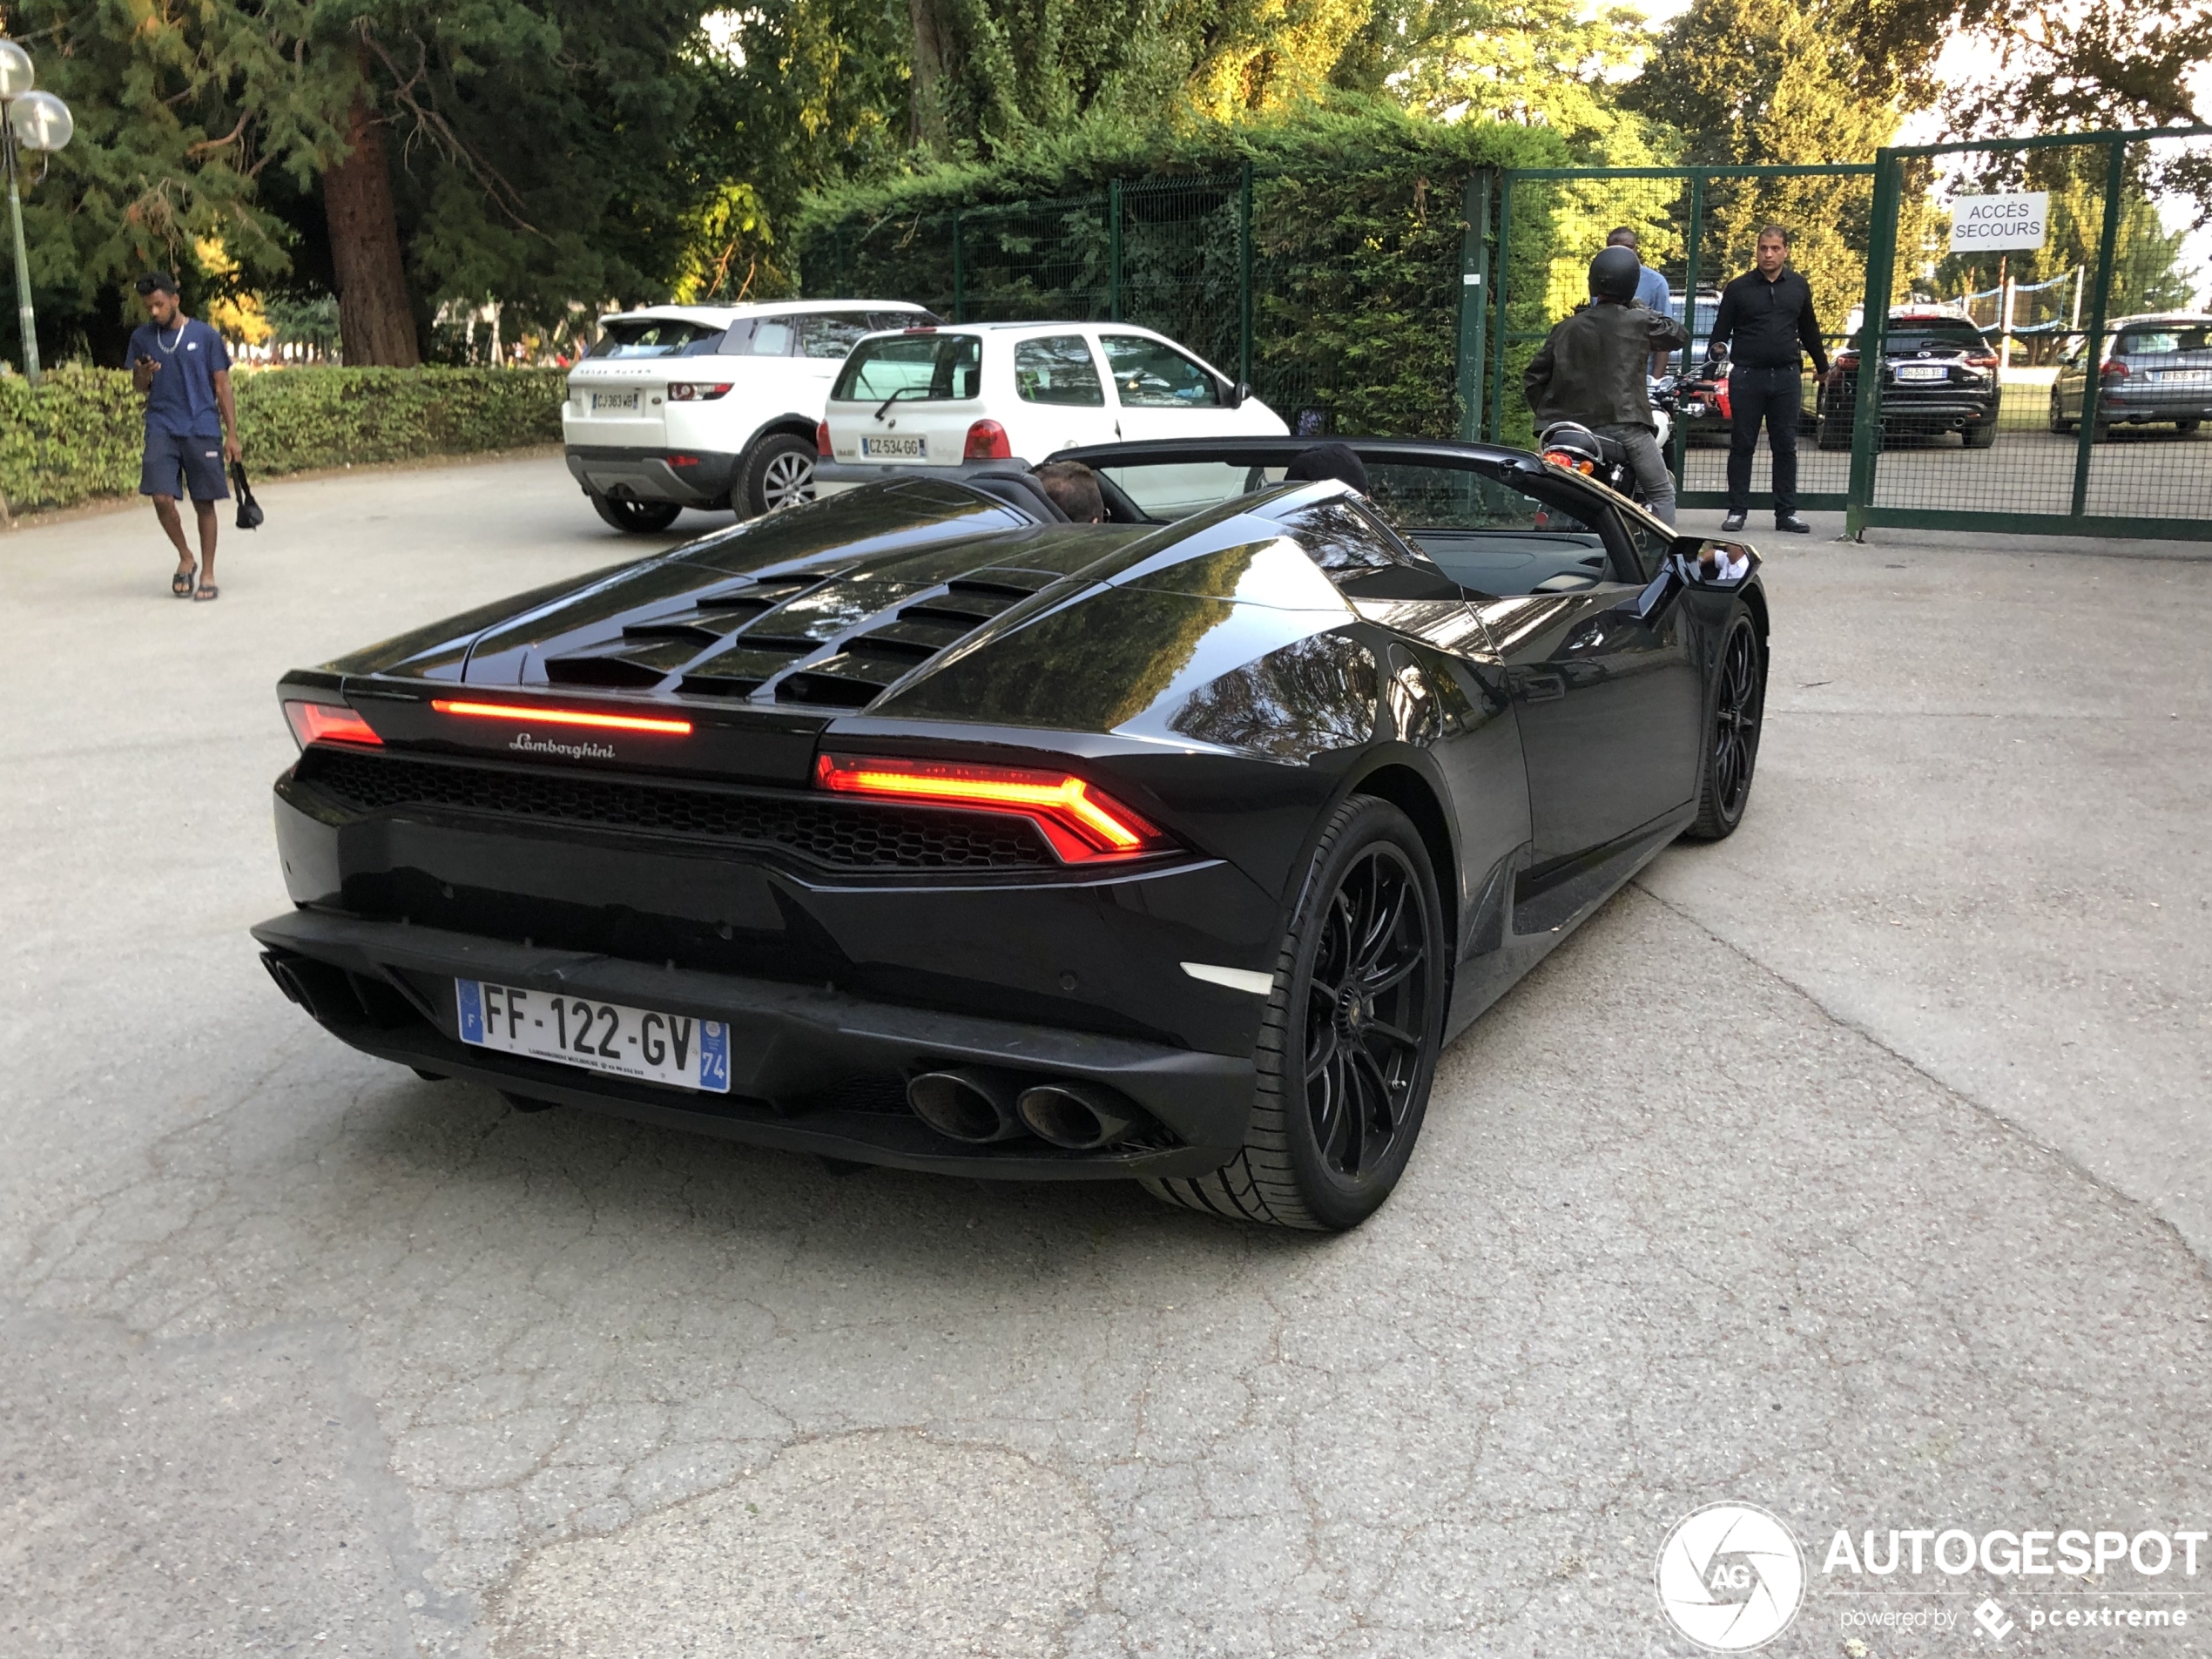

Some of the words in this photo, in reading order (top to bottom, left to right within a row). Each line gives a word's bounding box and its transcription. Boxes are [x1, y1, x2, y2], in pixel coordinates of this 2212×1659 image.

[1969, 201, 2029, 219] ACCÈS
[1955, 221, 2040, 239] SECOURS
[869, 439, 918, 455] CZ-534-GG
[509, 732, 616, 759] Lamborghini
[467, 1013, 475, 1028] F
[483, 984, 692, 1071] FF-122-GV
[702, 1051, 725, 1080] 74
